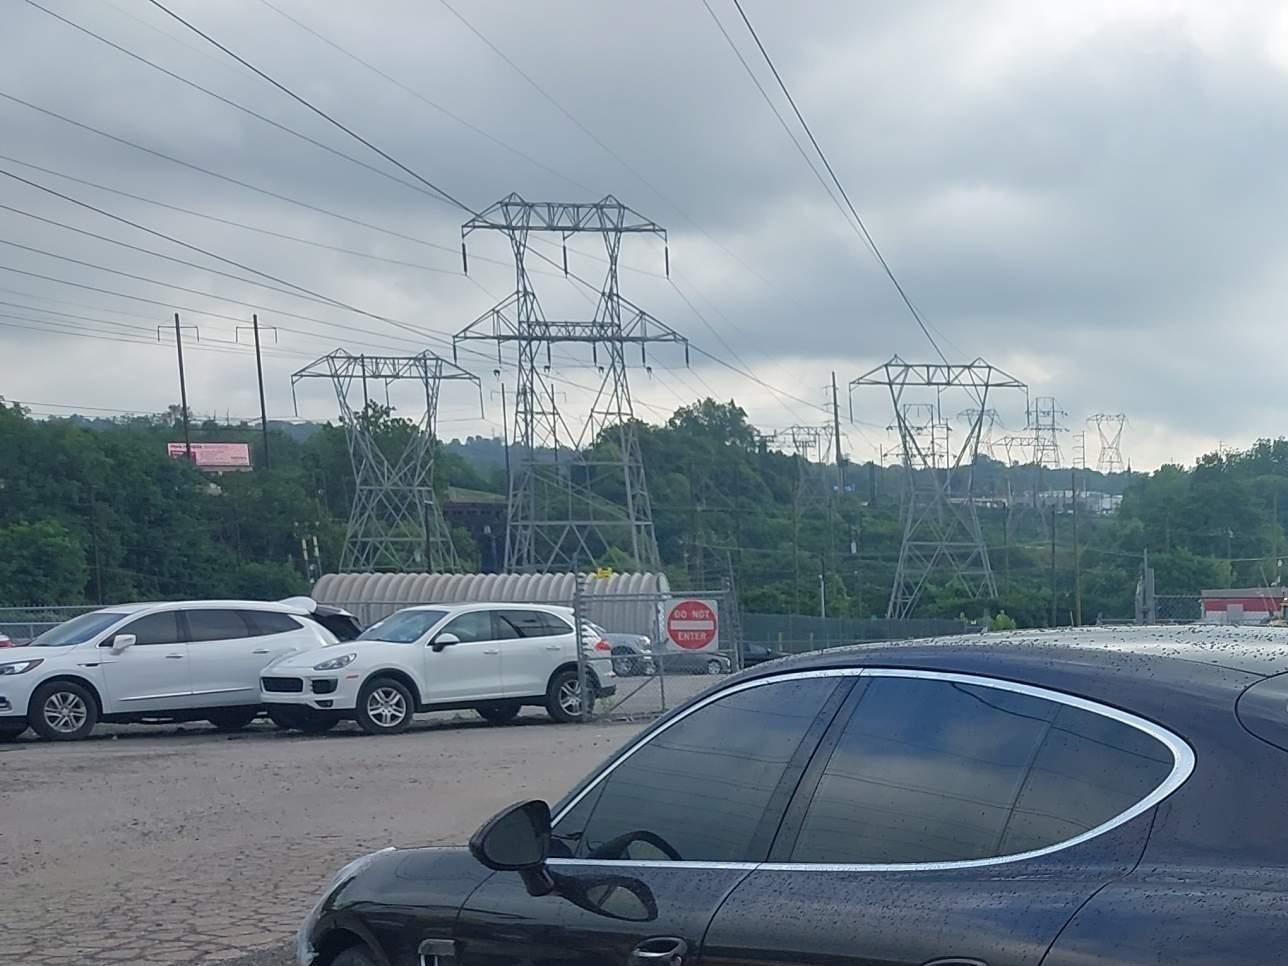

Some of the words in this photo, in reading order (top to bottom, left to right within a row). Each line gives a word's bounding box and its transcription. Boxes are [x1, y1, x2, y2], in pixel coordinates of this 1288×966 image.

[674, 609, 687, 619] DO
[692, 609, 710, 619] NOT
[678, 631, 707, 641] ENTER
